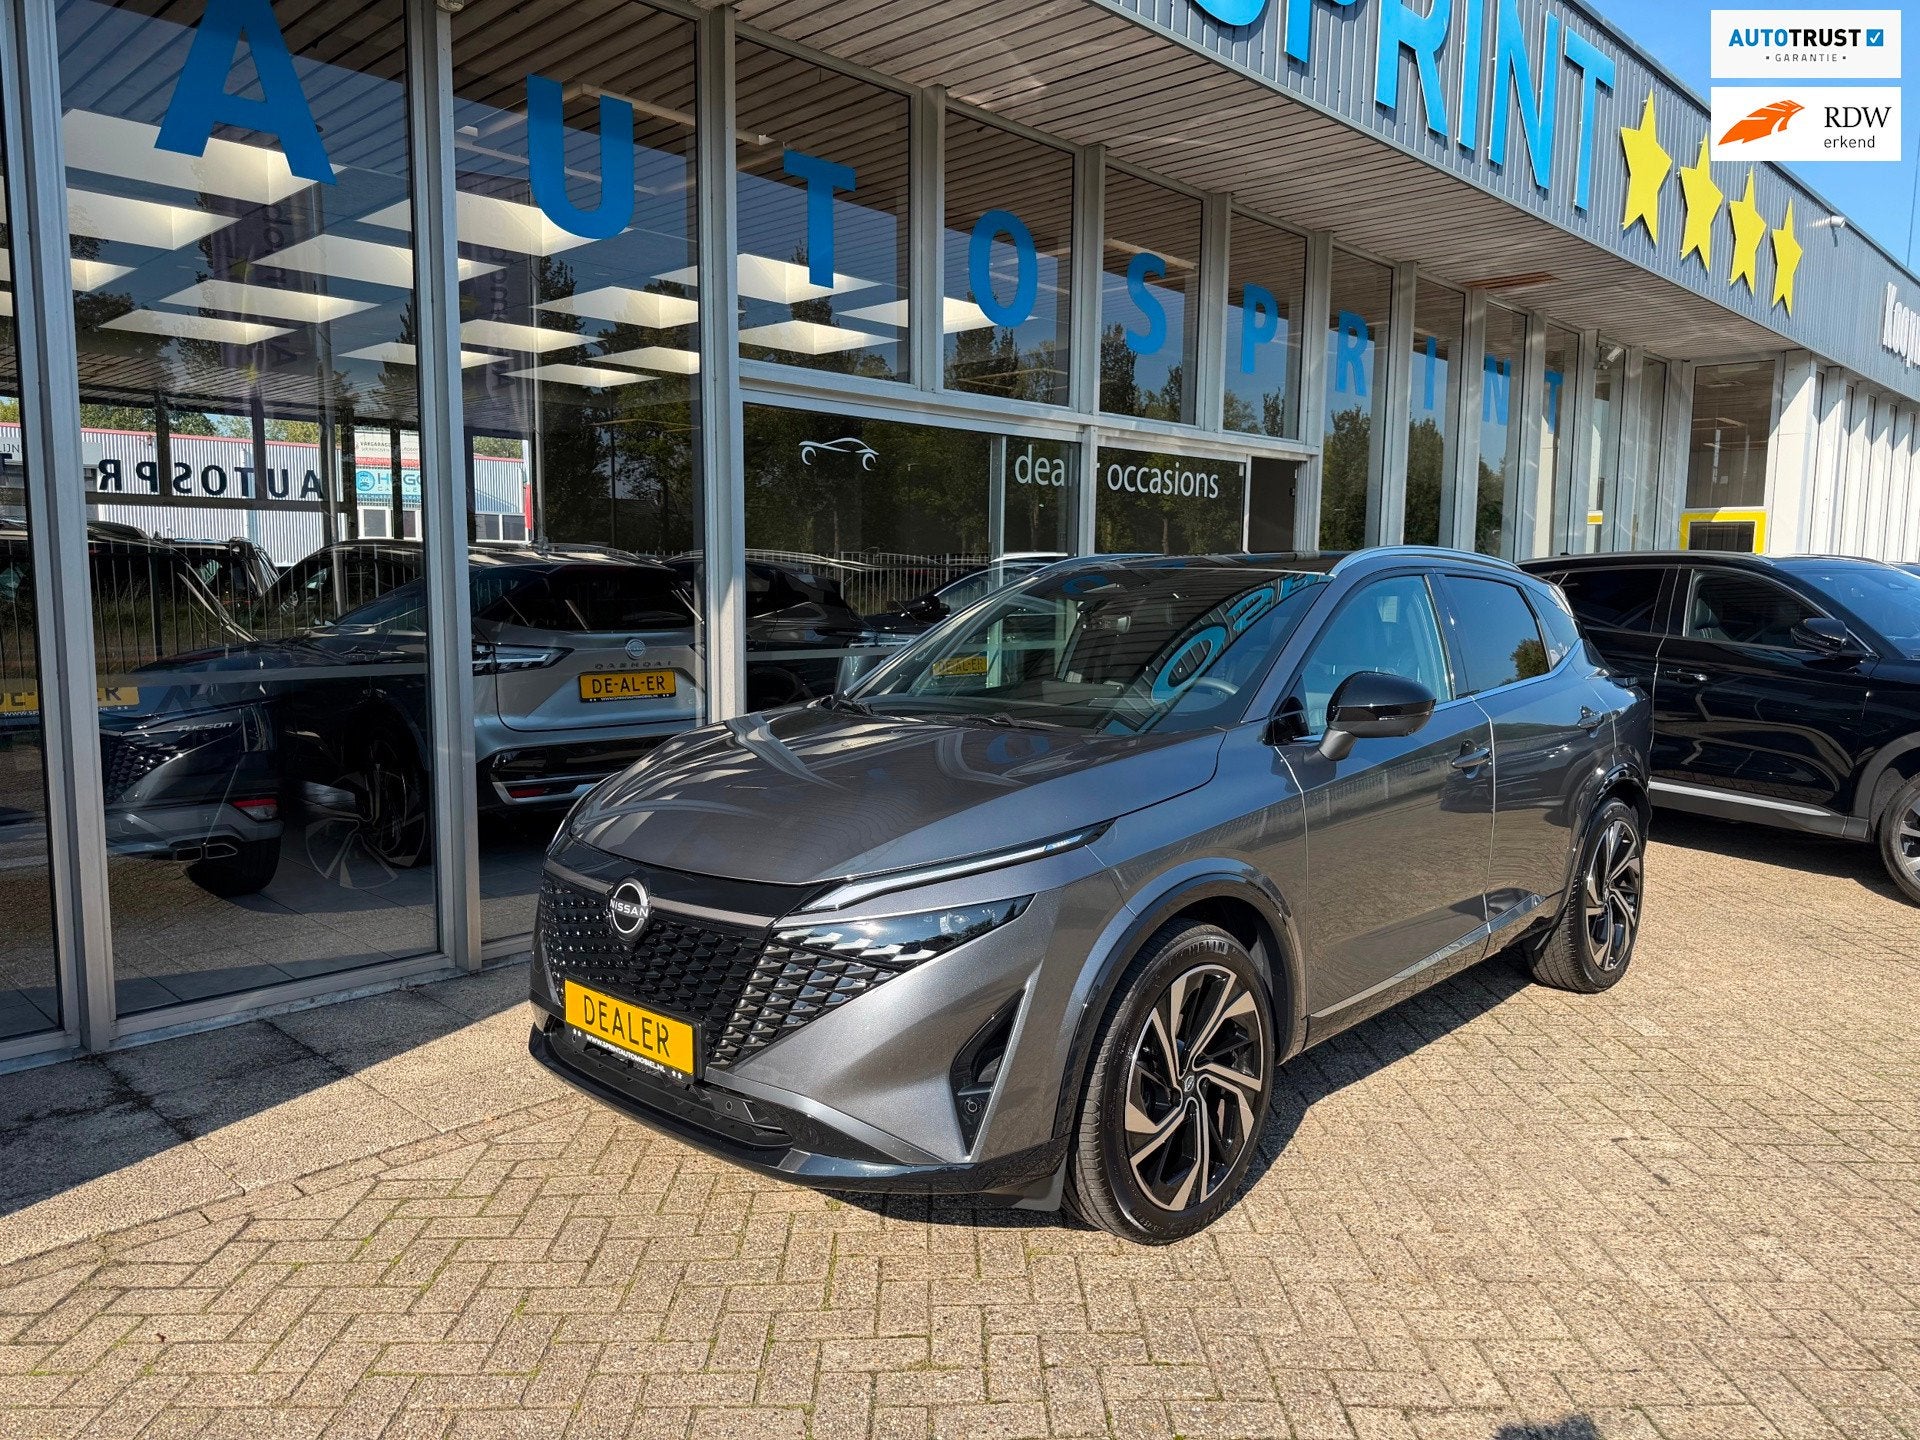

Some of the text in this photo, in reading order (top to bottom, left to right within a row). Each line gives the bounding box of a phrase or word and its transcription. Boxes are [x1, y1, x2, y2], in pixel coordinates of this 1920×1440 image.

[1185, 0, 1615, 211] RINT
[1106, 461, 1220, 499] occasions
[591, 675, 666, 695] DE-AL-ER
[610, 899, 649, 918] NISSAN
[583, 994, 671, 1058] DEALER
